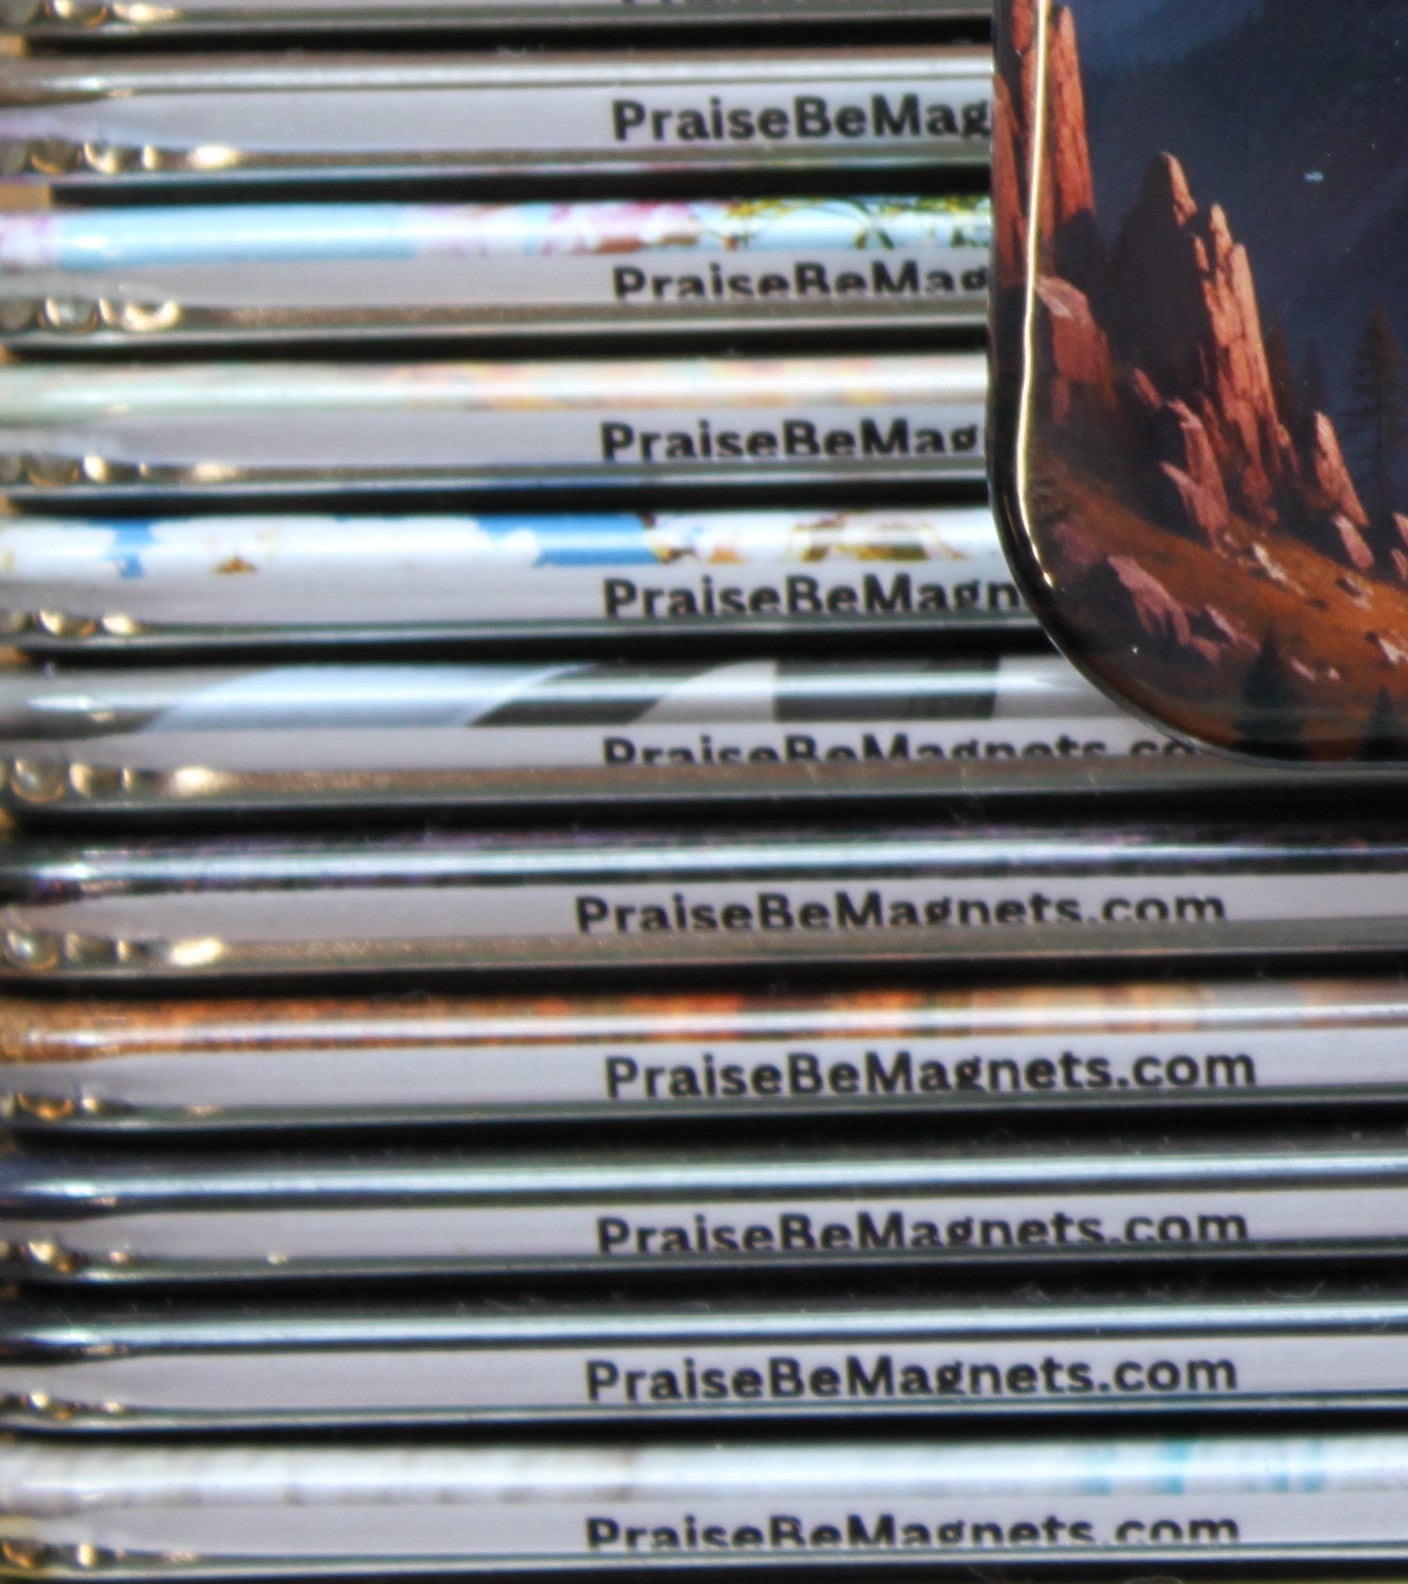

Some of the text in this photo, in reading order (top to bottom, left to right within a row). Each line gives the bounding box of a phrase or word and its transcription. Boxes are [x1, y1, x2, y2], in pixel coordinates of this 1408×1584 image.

[604, 1047, 1256, 1099] PraiseBeMagnets.com
[596, 1208, 1249, 1257] PraiseBeMagnets.com
[585, 1355, 1238, 1402] PraiseBeMagnets.com
[585, 1514, 1240, 1552] PraiseBeMagnetscom
